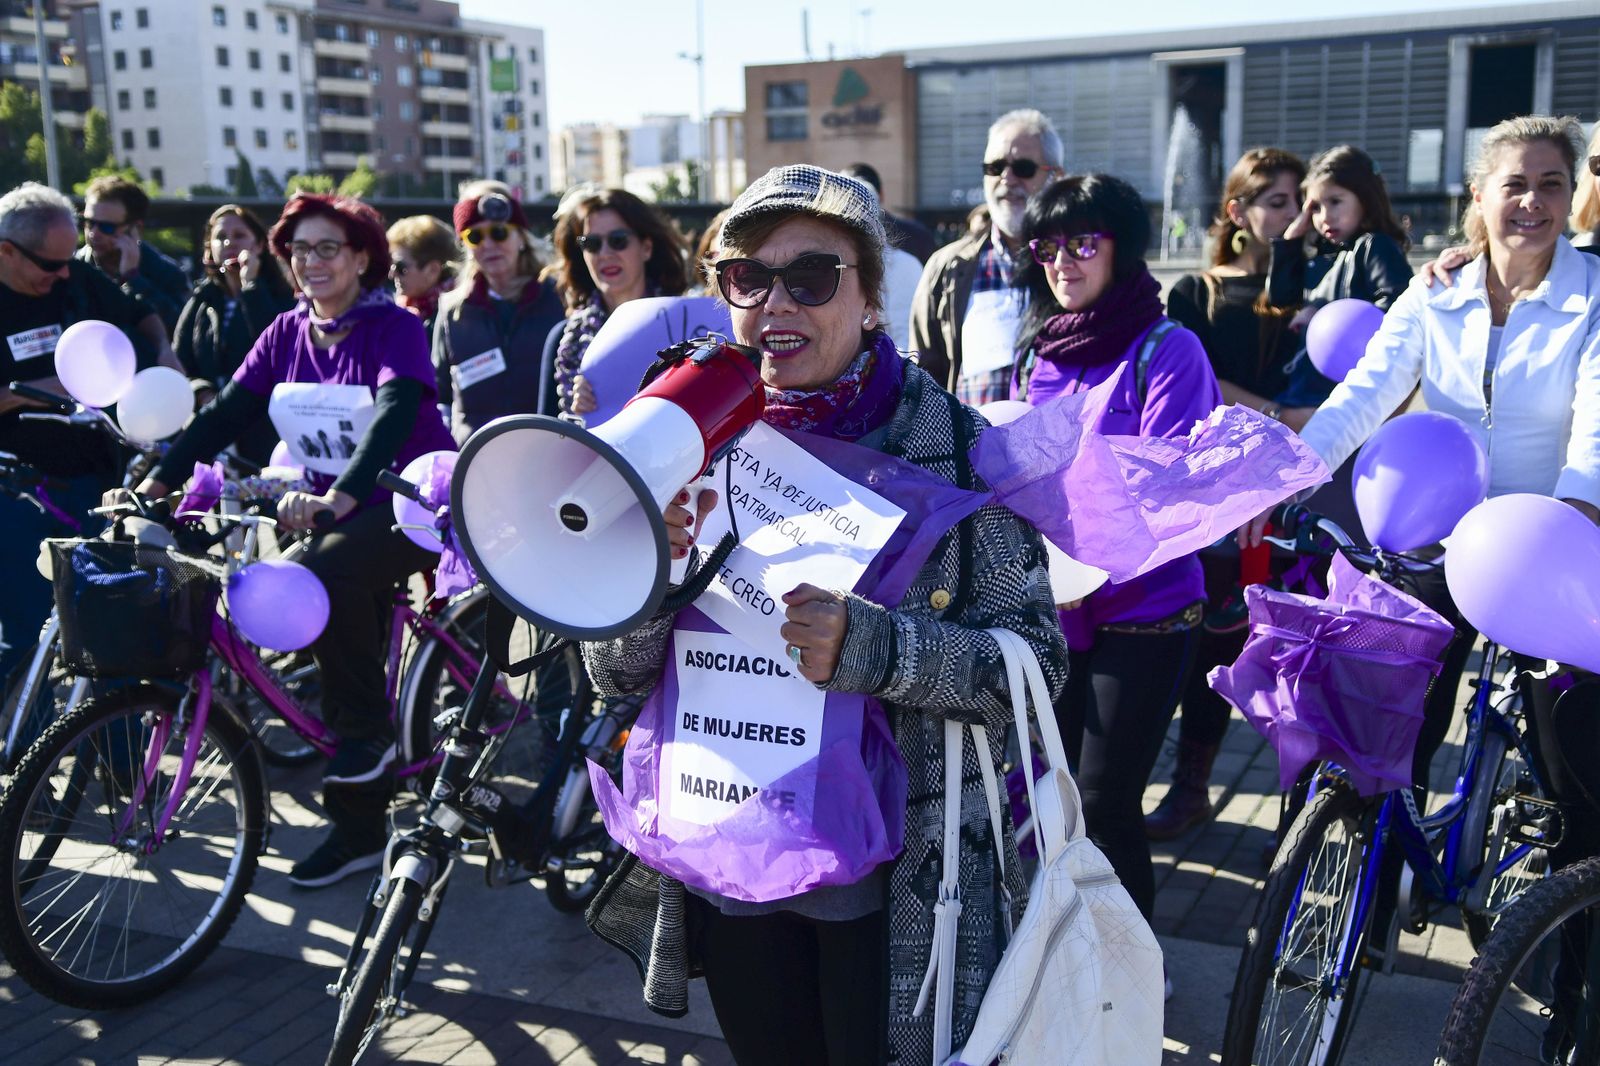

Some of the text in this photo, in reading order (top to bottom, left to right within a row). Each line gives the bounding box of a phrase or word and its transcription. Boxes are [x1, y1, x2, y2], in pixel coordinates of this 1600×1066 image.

[730, 447, 860, 541] STA YA DE JUSTICIA
[730, 485, 806, 546] PATRIARCAL
[732, 577, 776, 616] CREO
[685, 649, 798, 679] ASOCIACIO
[683, 712, 806, 746] DE MUJERES
